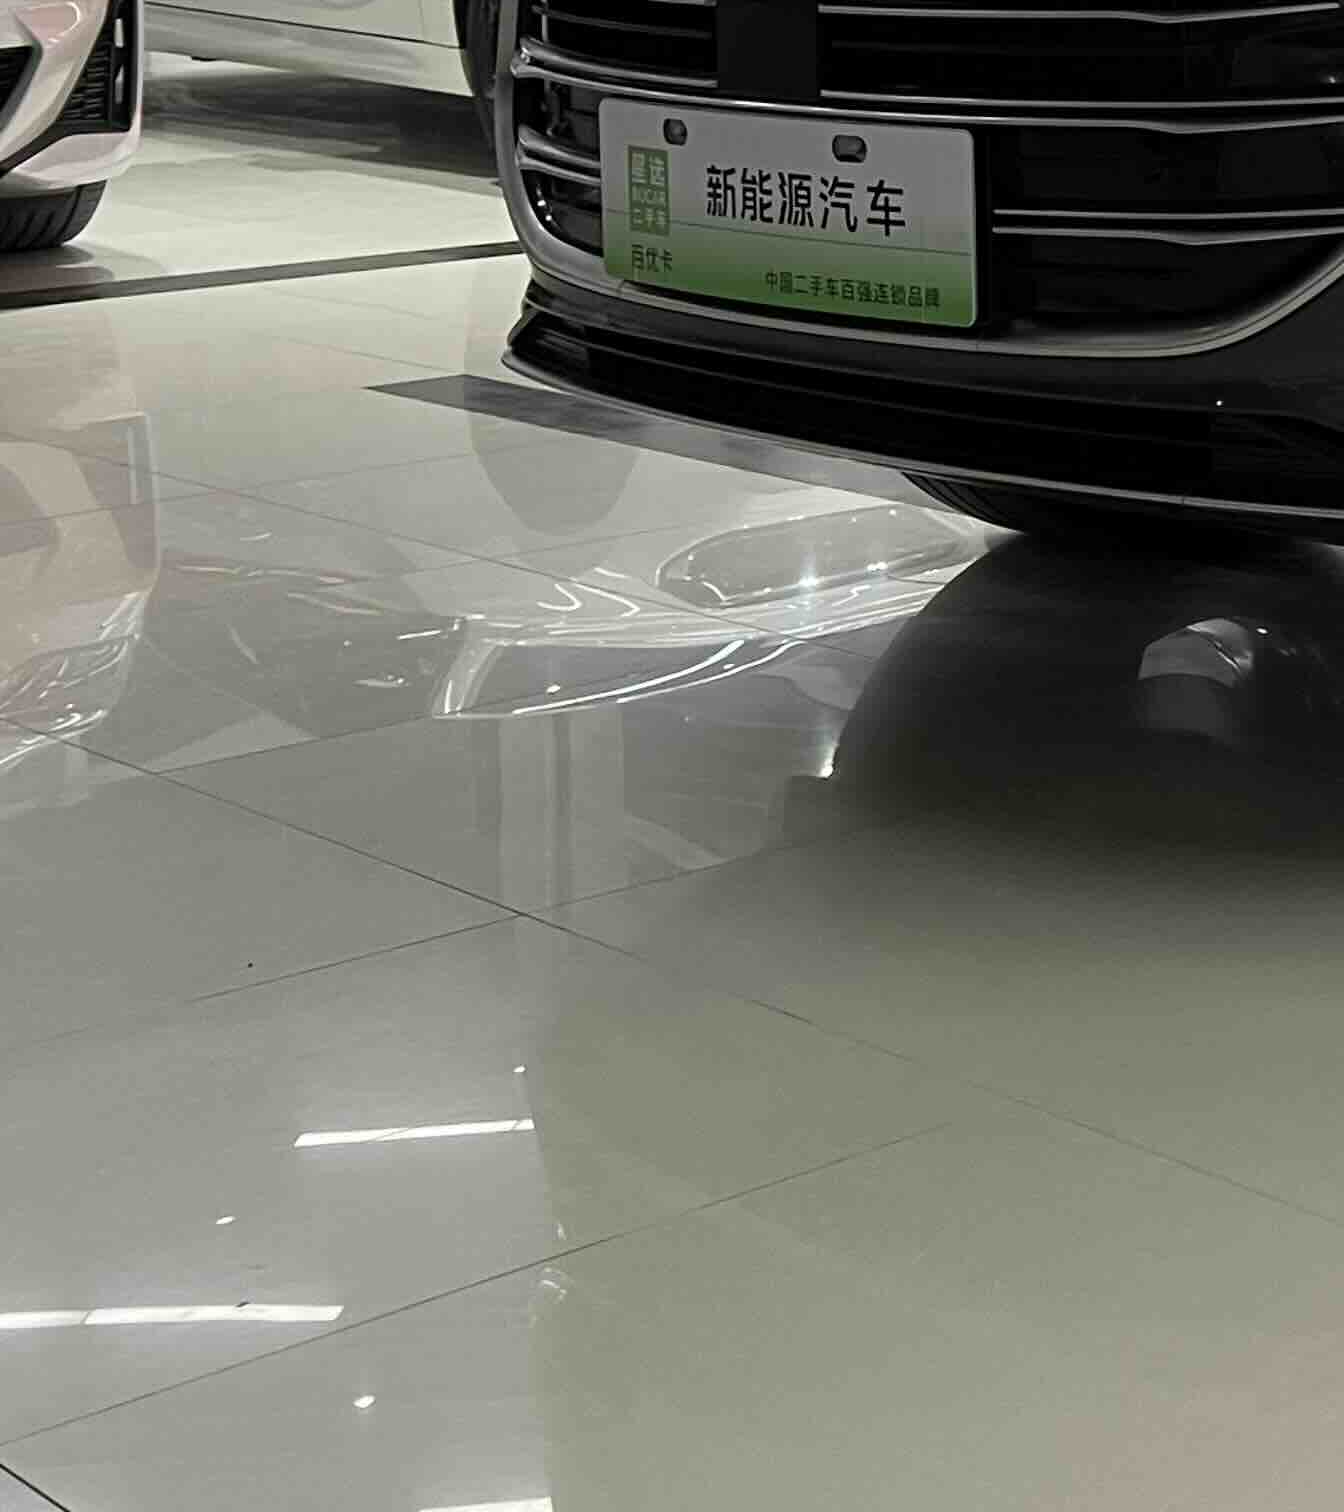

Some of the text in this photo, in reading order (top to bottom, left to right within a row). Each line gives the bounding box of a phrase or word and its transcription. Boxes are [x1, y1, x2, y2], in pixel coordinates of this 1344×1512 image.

[705, 164, 906, 237] 新能源汽车
